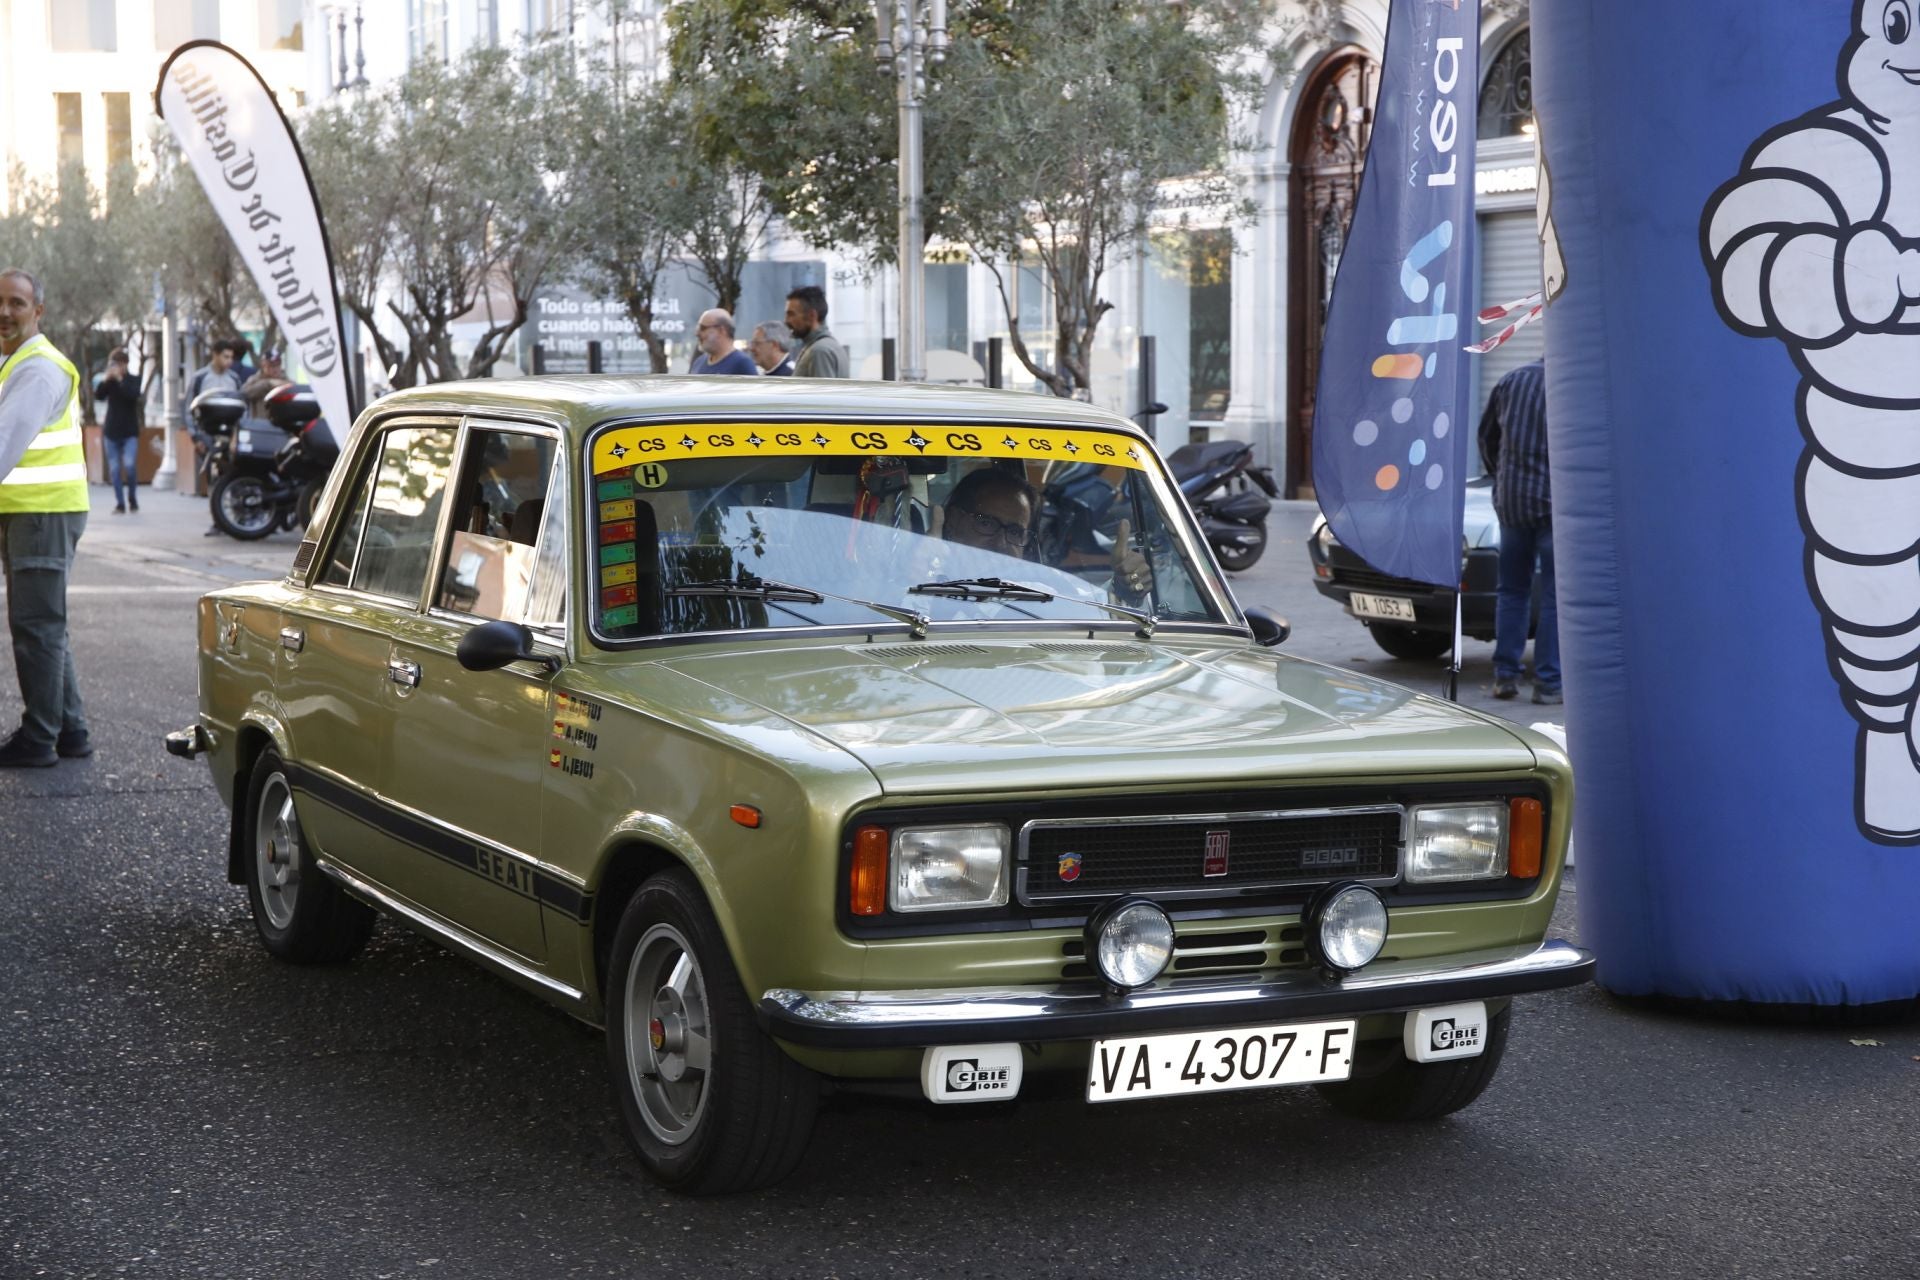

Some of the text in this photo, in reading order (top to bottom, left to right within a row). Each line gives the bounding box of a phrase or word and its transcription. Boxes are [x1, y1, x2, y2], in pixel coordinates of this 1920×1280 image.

[538, 298, 578, 314] Todo
[582, 303, 601, 314] es
[538, 316, 685, 332] cuando habmos
[558, 336, 614, 351] miso
[638, 438, 666, 452] CS
[708, 434, 735, 447] CS
[775, 433, 802, 446] CS
[851, 432, 888, 450] CS
[909, 437, 925, 446] CS
[946, 433, 982, 451] CS
[1028, 438, 1052, 451] CS
[1093, 443, 1115, 457] CS
[642, 464, 660, 485] H
[1354, 595, 1412, 617] VA 1053 J
[1206, 834, 1229, 859] SEAT
[1303, 849, 1357, 864] SEAT
[479, 848, 530, 893] SEAT
[1455, 1039, 1479, 1047] IODE
